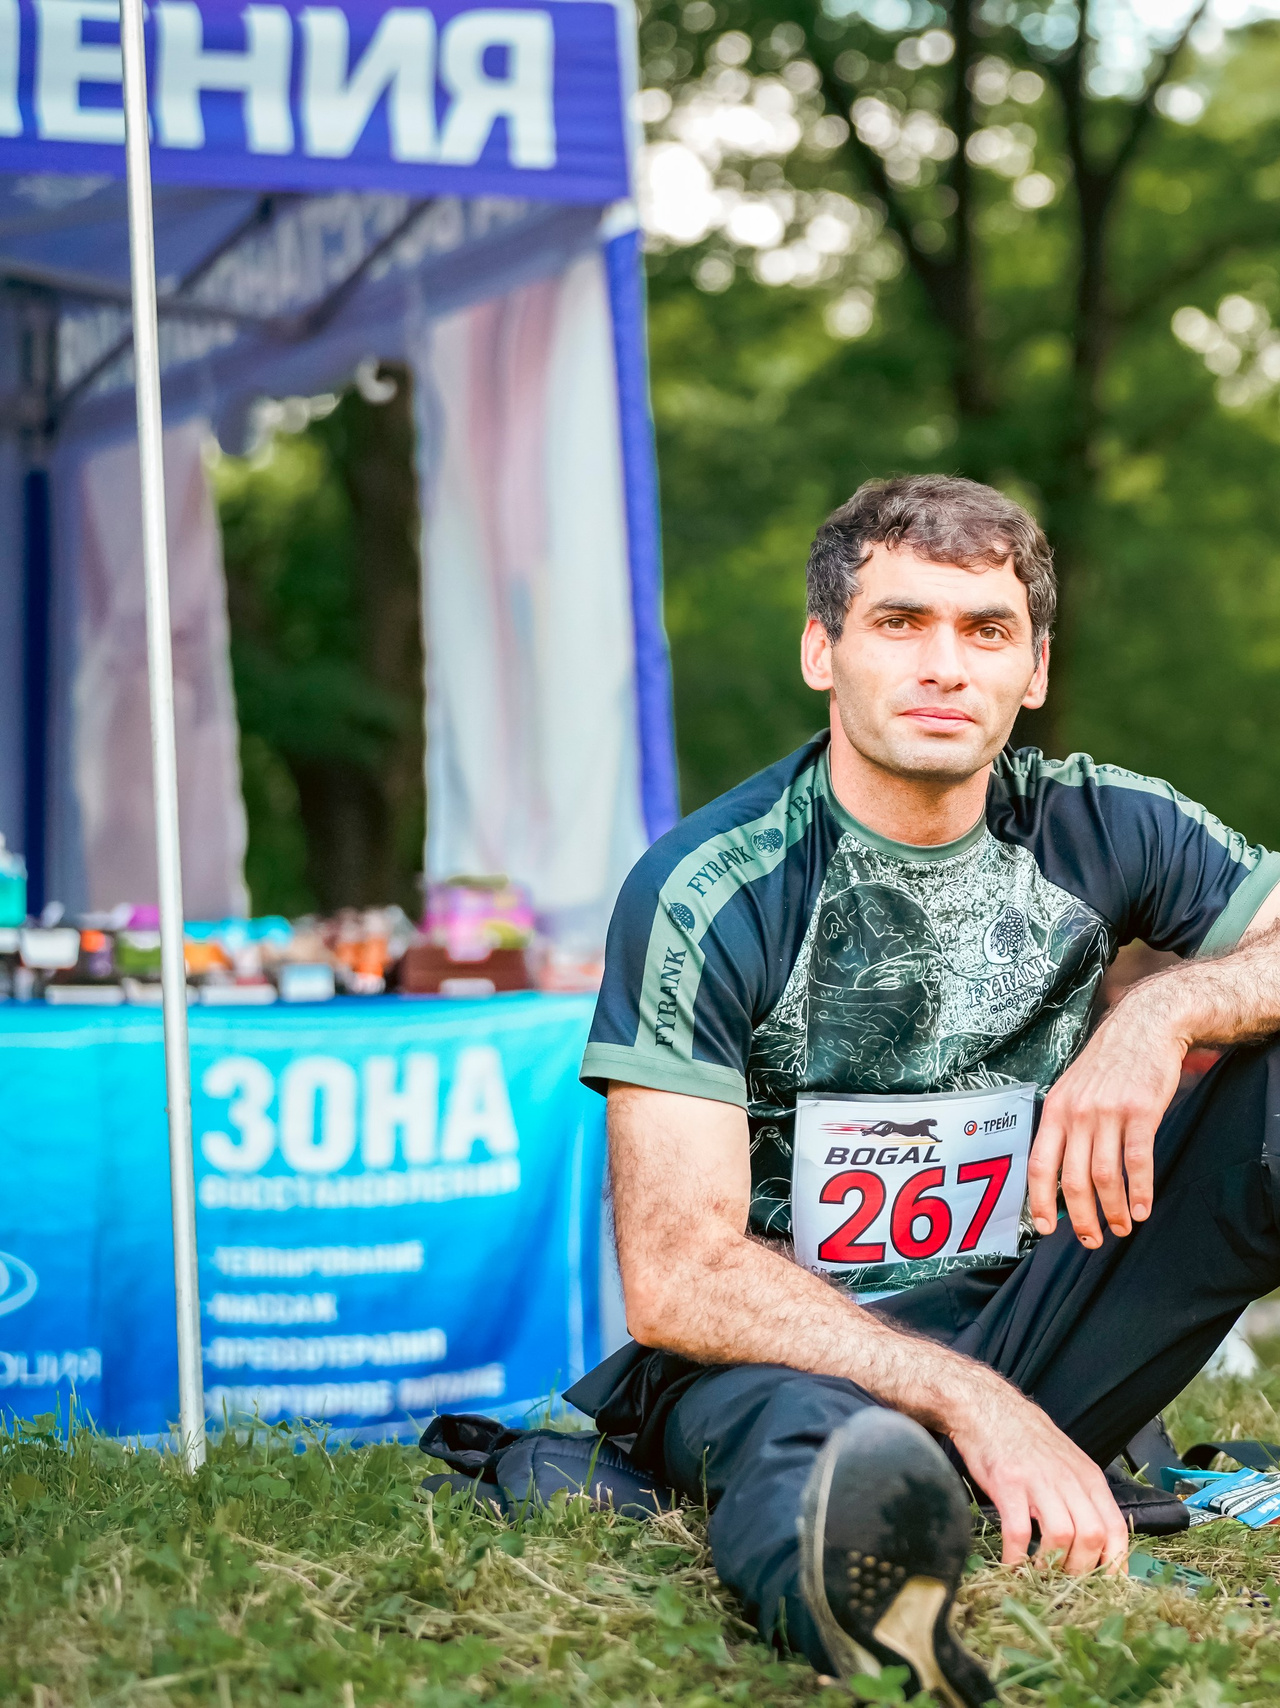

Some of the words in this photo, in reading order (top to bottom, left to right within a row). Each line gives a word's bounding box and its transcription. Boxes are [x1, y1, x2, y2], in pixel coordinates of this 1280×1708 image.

[687, 846, 755, 897] FYRANK
[655, 946, 687, 1049] FYRANK
[970, 950, 1060, 1008] FYRANK
[990, 982, 1050, 1014] CLOTHING
[201, 1045, 520, 1174] ЗОНА
[824, 1145, 943, 1165] BOGAL
[818, 1154, 1013, 1264] 267
